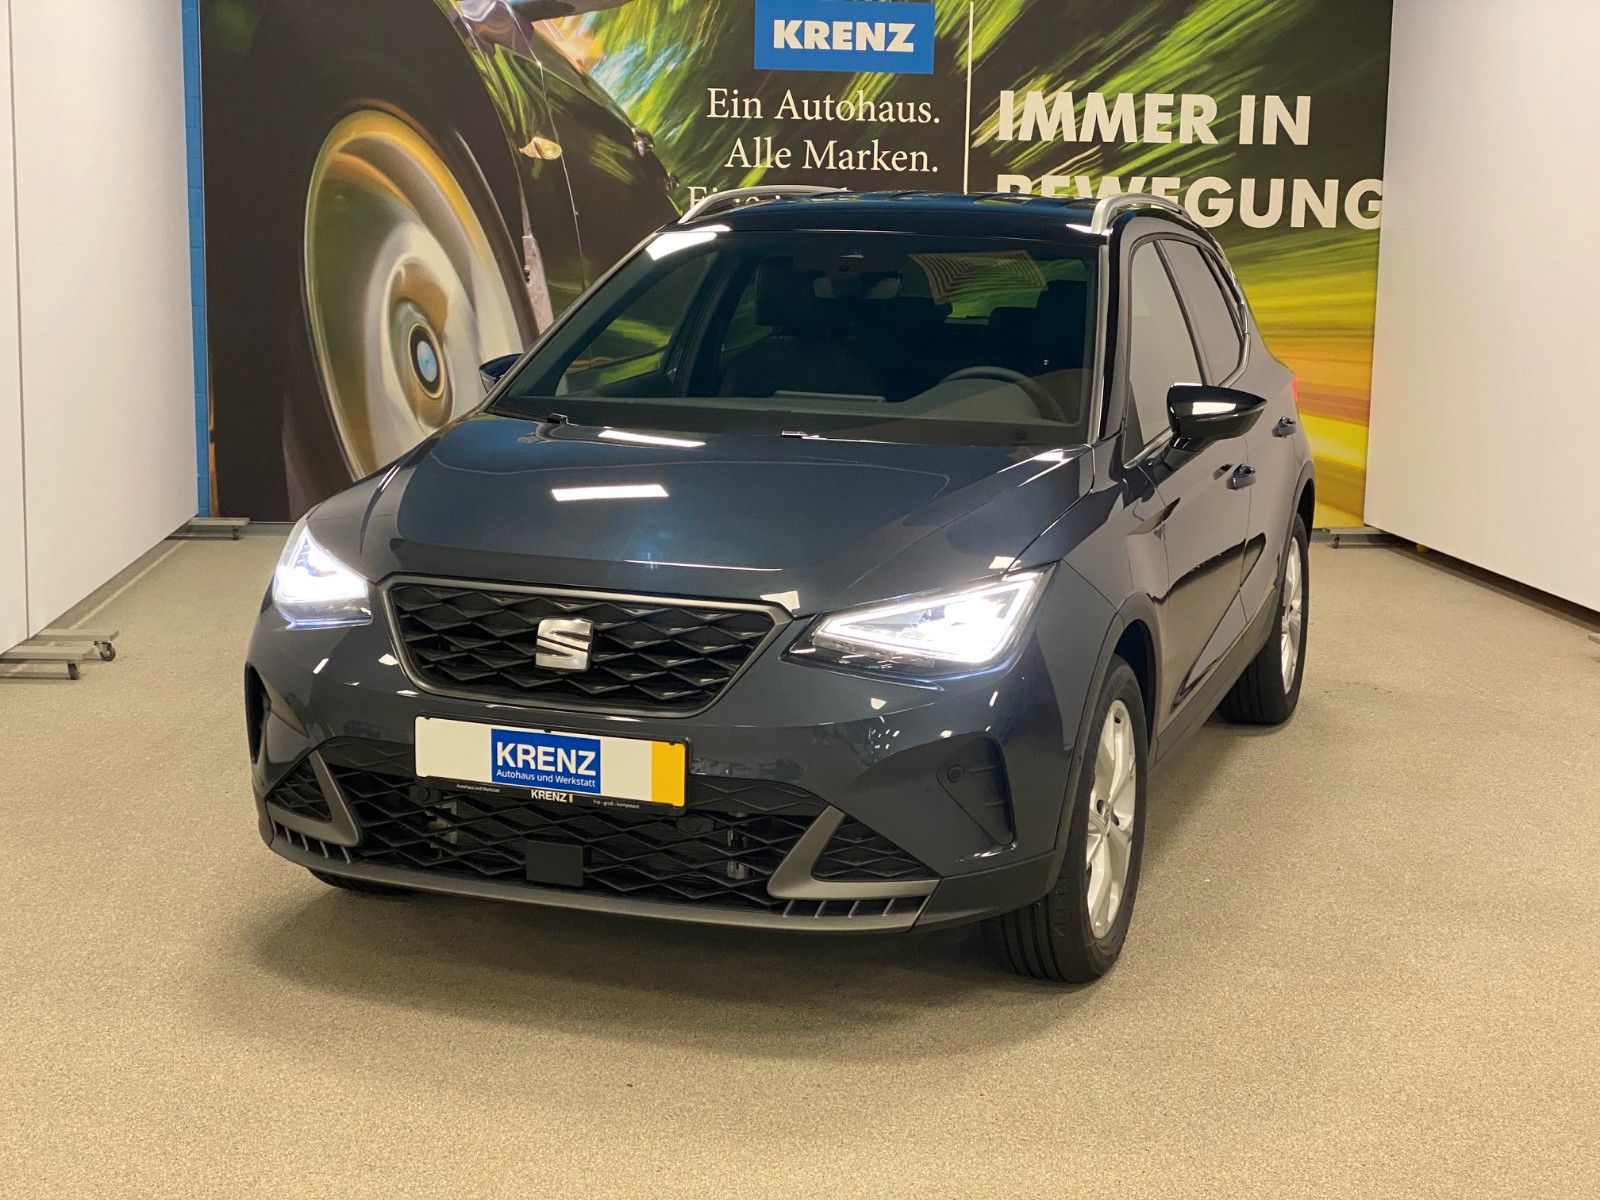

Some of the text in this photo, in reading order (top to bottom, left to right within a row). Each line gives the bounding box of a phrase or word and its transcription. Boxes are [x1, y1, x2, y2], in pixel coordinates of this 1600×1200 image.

[773, 19, 916, 53] KRENZ
[706, 87, 941, 124] Ein Autohaus.
[998, 89, 1311, 146] IMMER IN
[723, 137, 939, 172] Alle Marken.
[496, 741, 596, 776] KRENZ
[496, 769, 596, 788] Autohaus und Werkstatt
[531, 790, 567, 803] KRENZ
